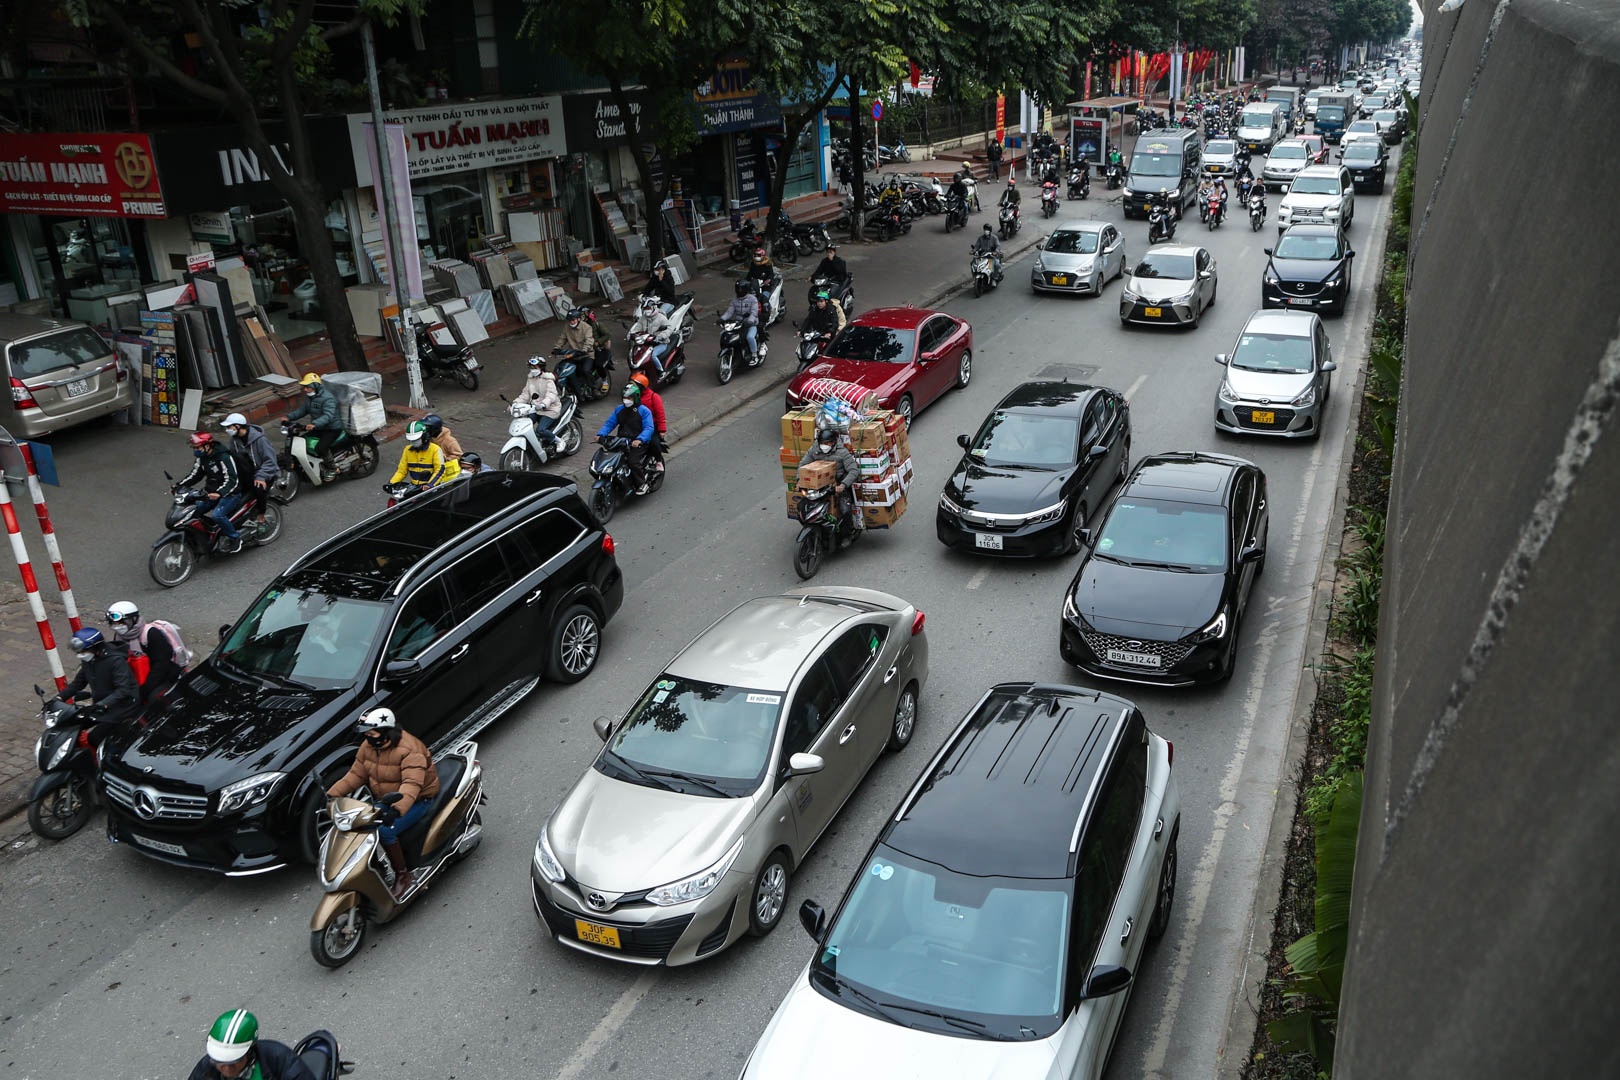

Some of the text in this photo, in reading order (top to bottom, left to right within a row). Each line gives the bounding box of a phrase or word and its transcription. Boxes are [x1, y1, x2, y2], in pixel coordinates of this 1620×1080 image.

[402, 116, 414, 124] TY
[416, 113, 441, 122] TNHH
[442, 109, 462, 119] ĐẦU
[476, 108, 489, 116] TM
[490, 106, 502, 115] VÀ
[503, 106, 515, 114] XD
[516, 103, 530, 114] NỘI
[531, 101, 550, 110] THẤT
[729, 106, 754, 122] THÀNH
[412, 118, 550, 152] TUẤN MẠNH
[418, 158, 429, 166] ỐP
[431, 155, 444, 165] LÁT
[446, 154, 456, 162] VÀ
[459, 151, 477, 160] THIẾT
[513, 145, 527, 153] CAO
[218, 142, 295, 186] INA
[50, 161, 109, 189] MẠNH
[30, 191, 40, 201] LÁT
[88, 194, 100, 203] CAO
[122, 201, 165, 215] PRIME
[1111, 651, 1157, 665] 89A-312.44
[587, 923, 606, 935] 30F
[582, 930, 616, 946] 905.35
